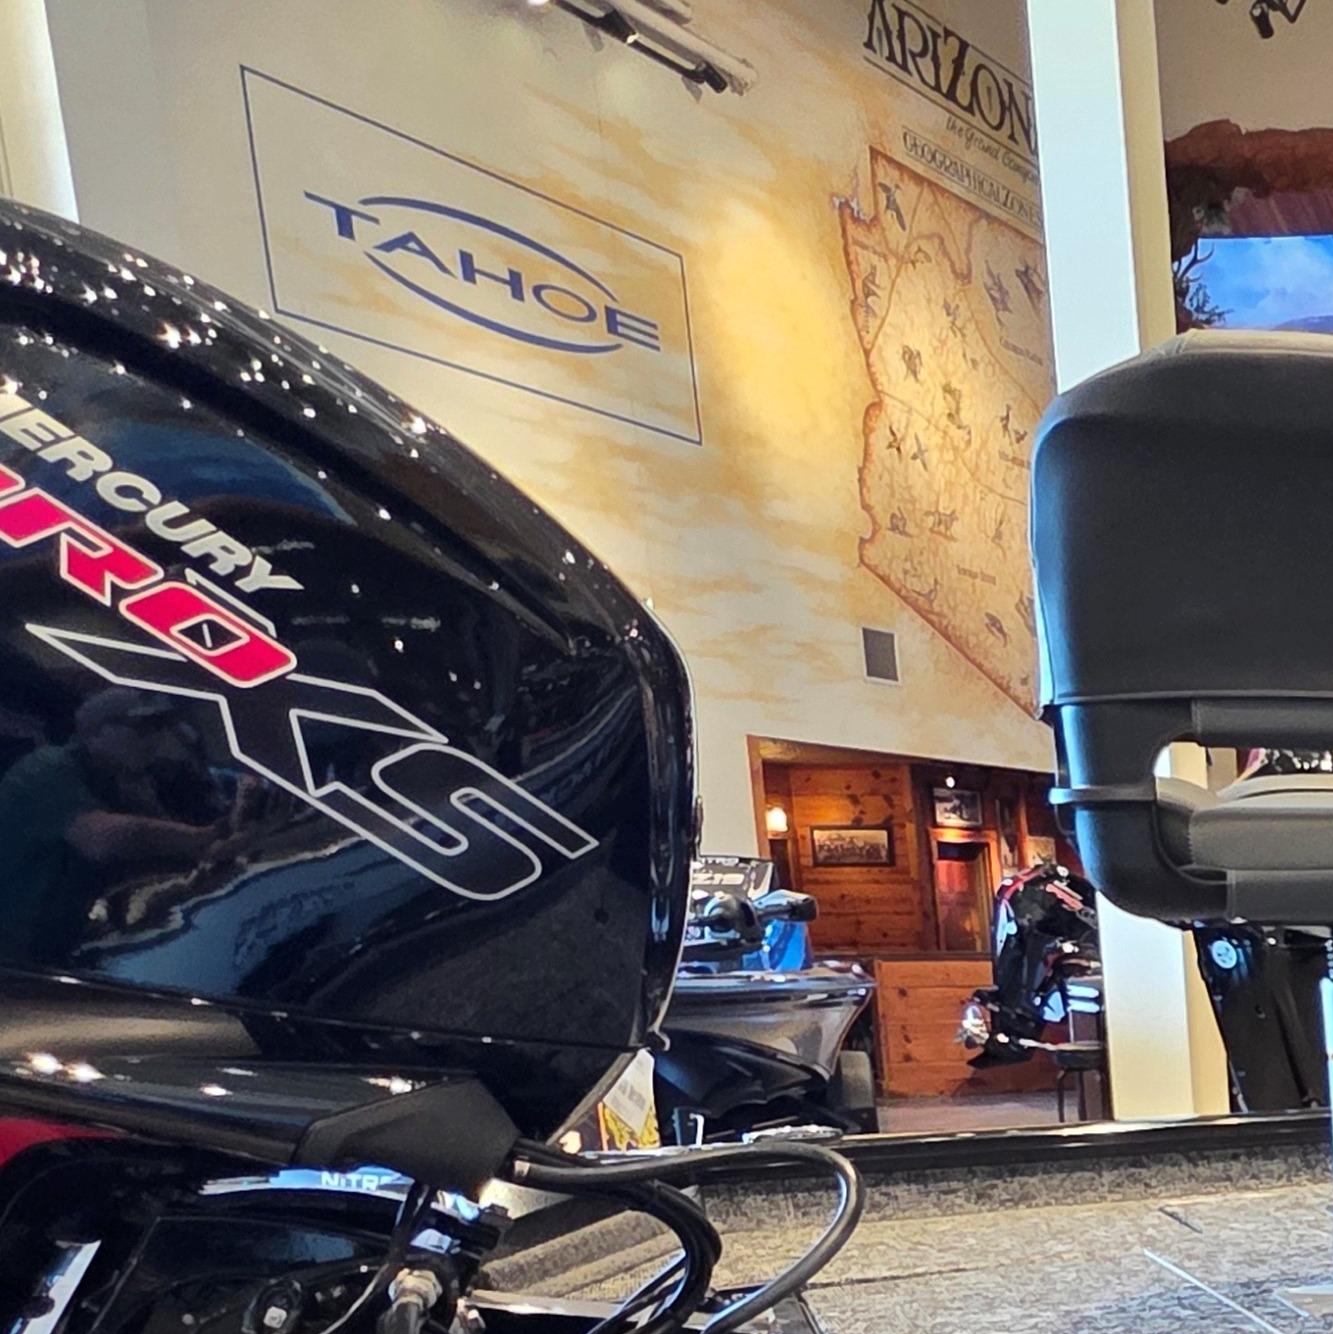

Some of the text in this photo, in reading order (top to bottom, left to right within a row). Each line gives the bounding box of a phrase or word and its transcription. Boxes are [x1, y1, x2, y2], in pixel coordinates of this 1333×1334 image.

[862, 0, 1037, 155] ARIZON
[303, 190, 661, 352] TAHOE
[0, 462, 297, 688] RO
